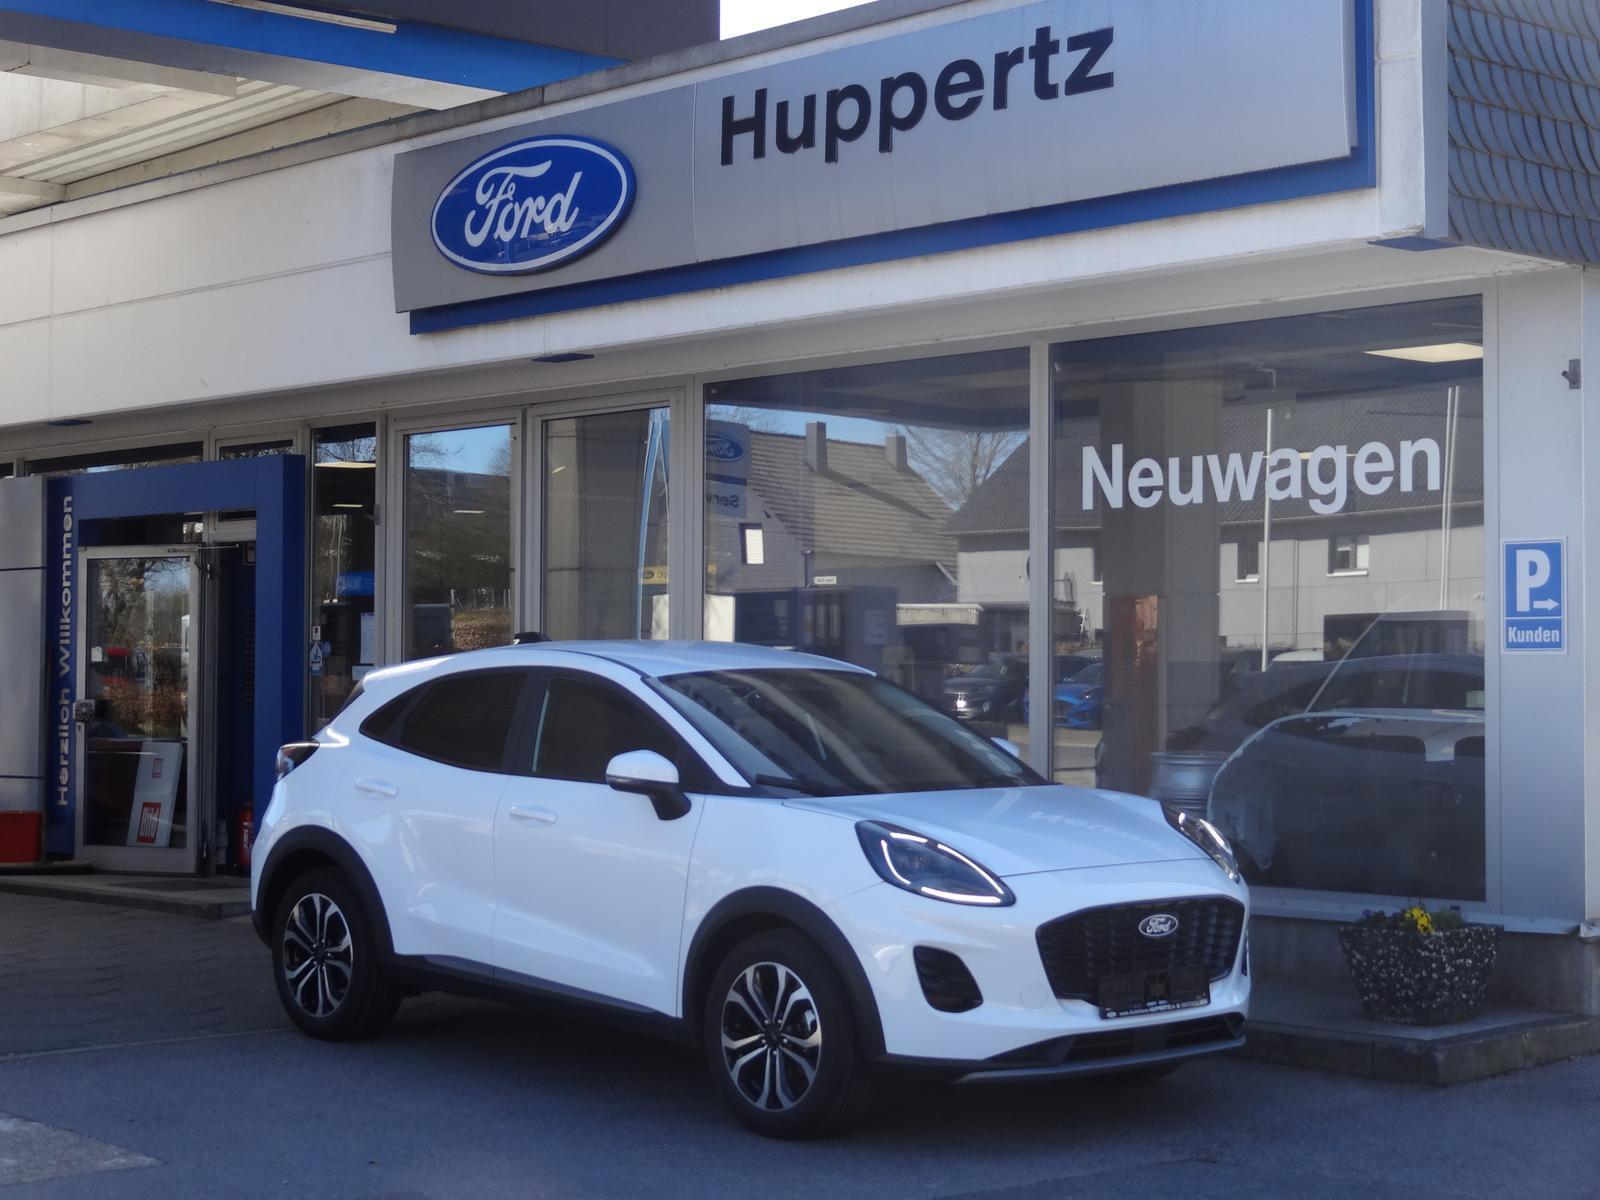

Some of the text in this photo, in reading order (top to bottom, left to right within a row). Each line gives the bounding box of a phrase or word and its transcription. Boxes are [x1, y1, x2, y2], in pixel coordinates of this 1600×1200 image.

[720, 26, 1114, 165] Huppertz
[464, 160, 583, 248] Ford
[1081, 436, 1441, 515] Neuwagen
[1516, 548, 1551, 612] P
[57, 496, 73, 806] Herzlich Willkommen
[1507, 626, 1560, 643] Kunden
[1146, 917, 1171, 933] Ford
